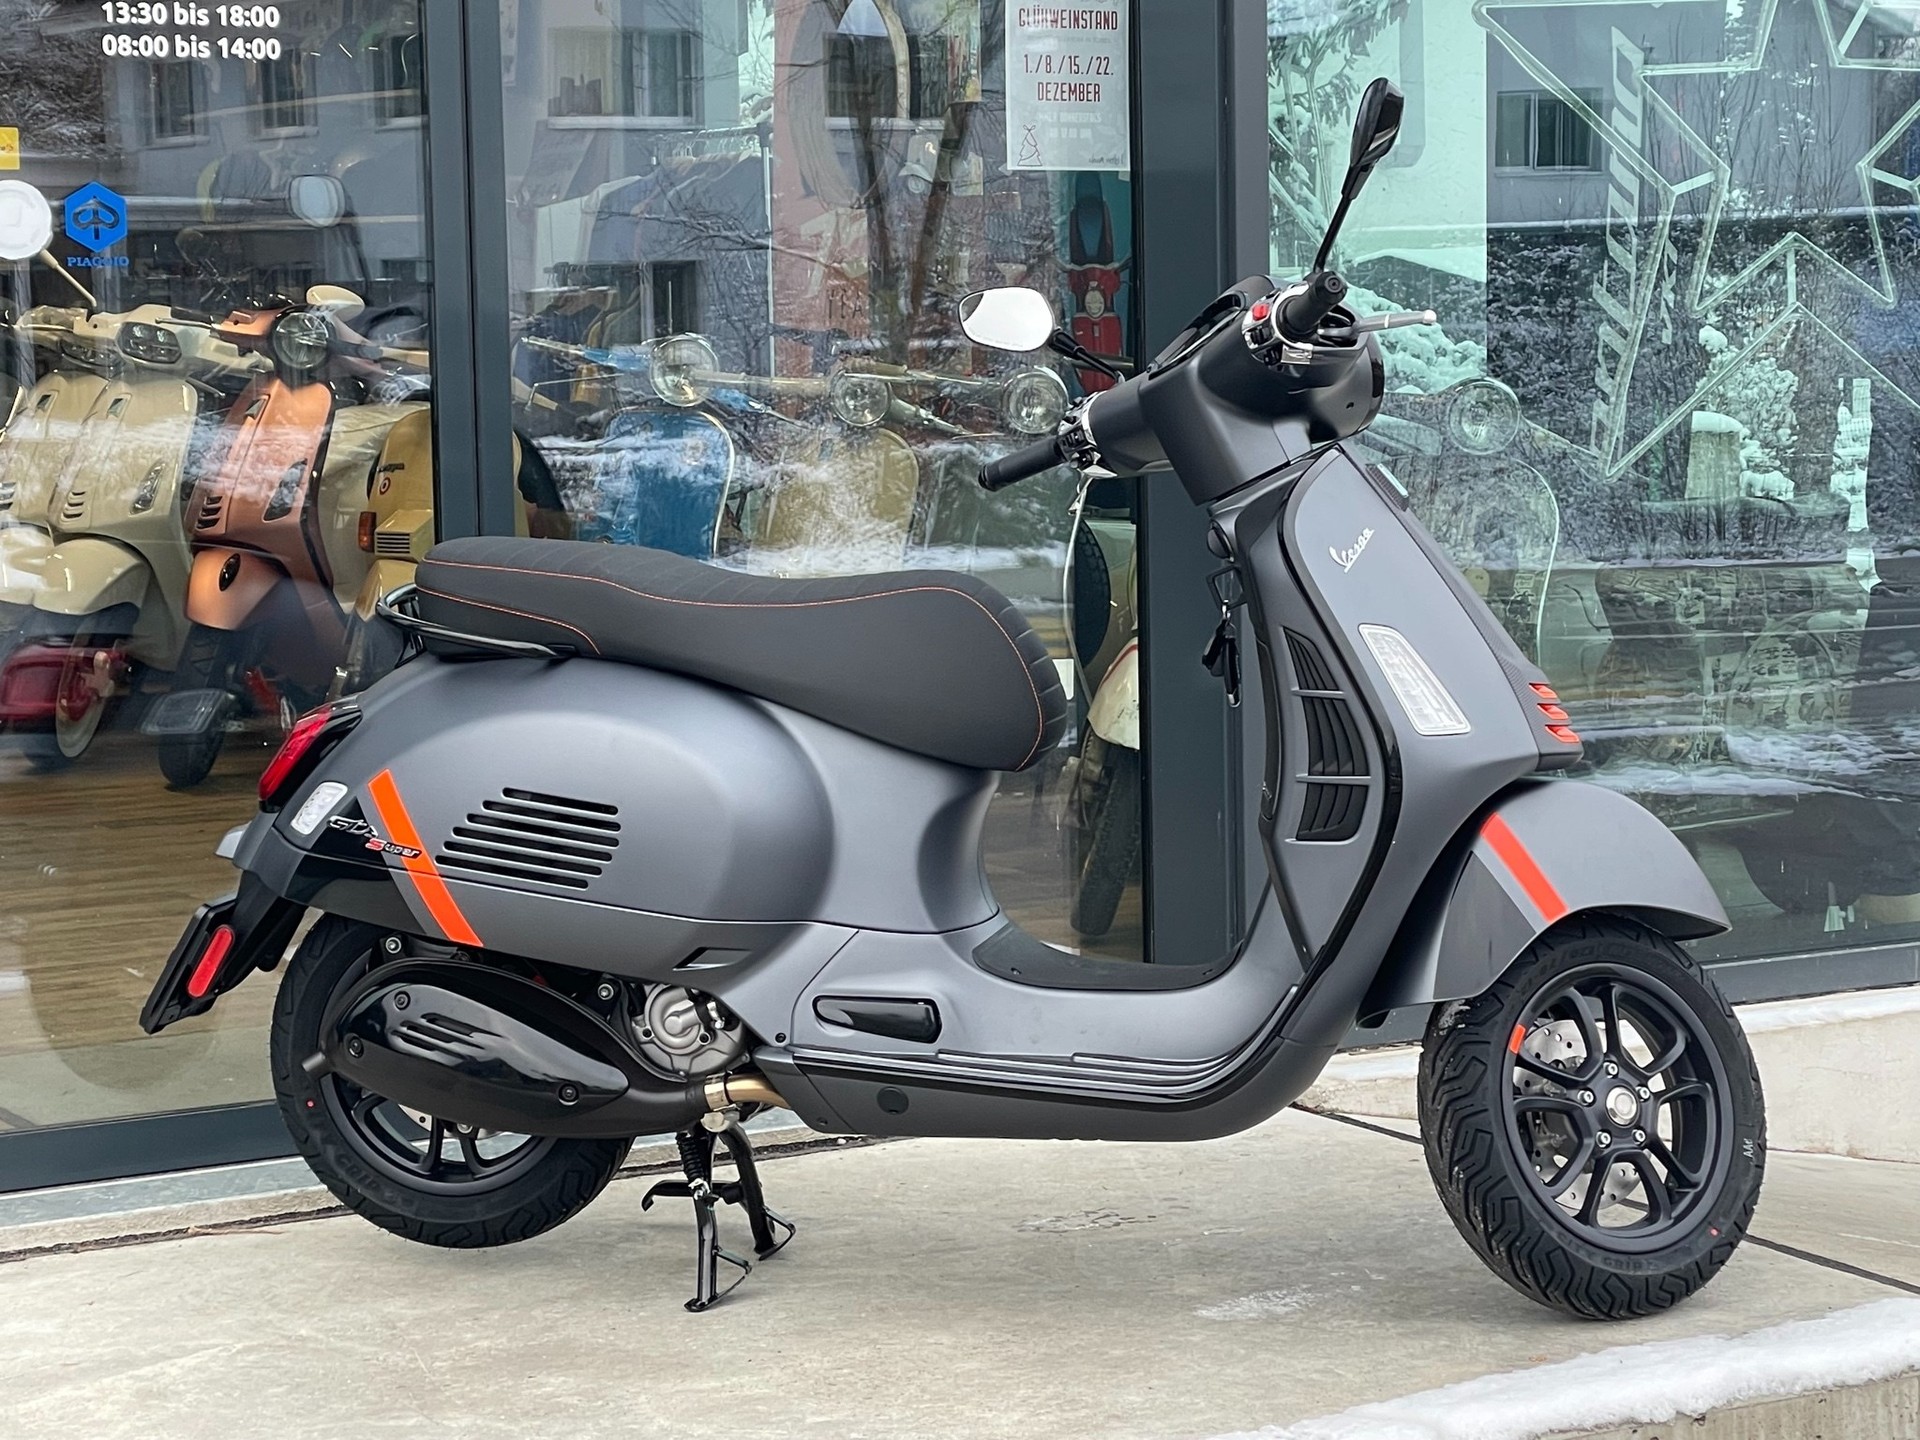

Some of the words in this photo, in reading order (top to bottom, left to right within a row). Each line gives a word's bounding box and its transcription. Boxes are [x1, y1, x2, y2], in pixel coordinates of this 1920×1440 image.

[101, 1, 168, 25] 13:30
[173, 1, 210, 26] bis
[215, 5, 280, 28] 18:00
[1019, 4, 1118, 30] GLÜHWEINSTAND
[101, 34, 169, 57] 08:00
[174, 34, 211, 58] bis
[216, 37, 281, 60] 14:00
[1037, 81, 1101, 102] DEZEMBER
[67, 256, 129, 267] PIAGGIO
[1328, 527, 1375, 574] Vespa
[365, 838, 421, 859] Super
